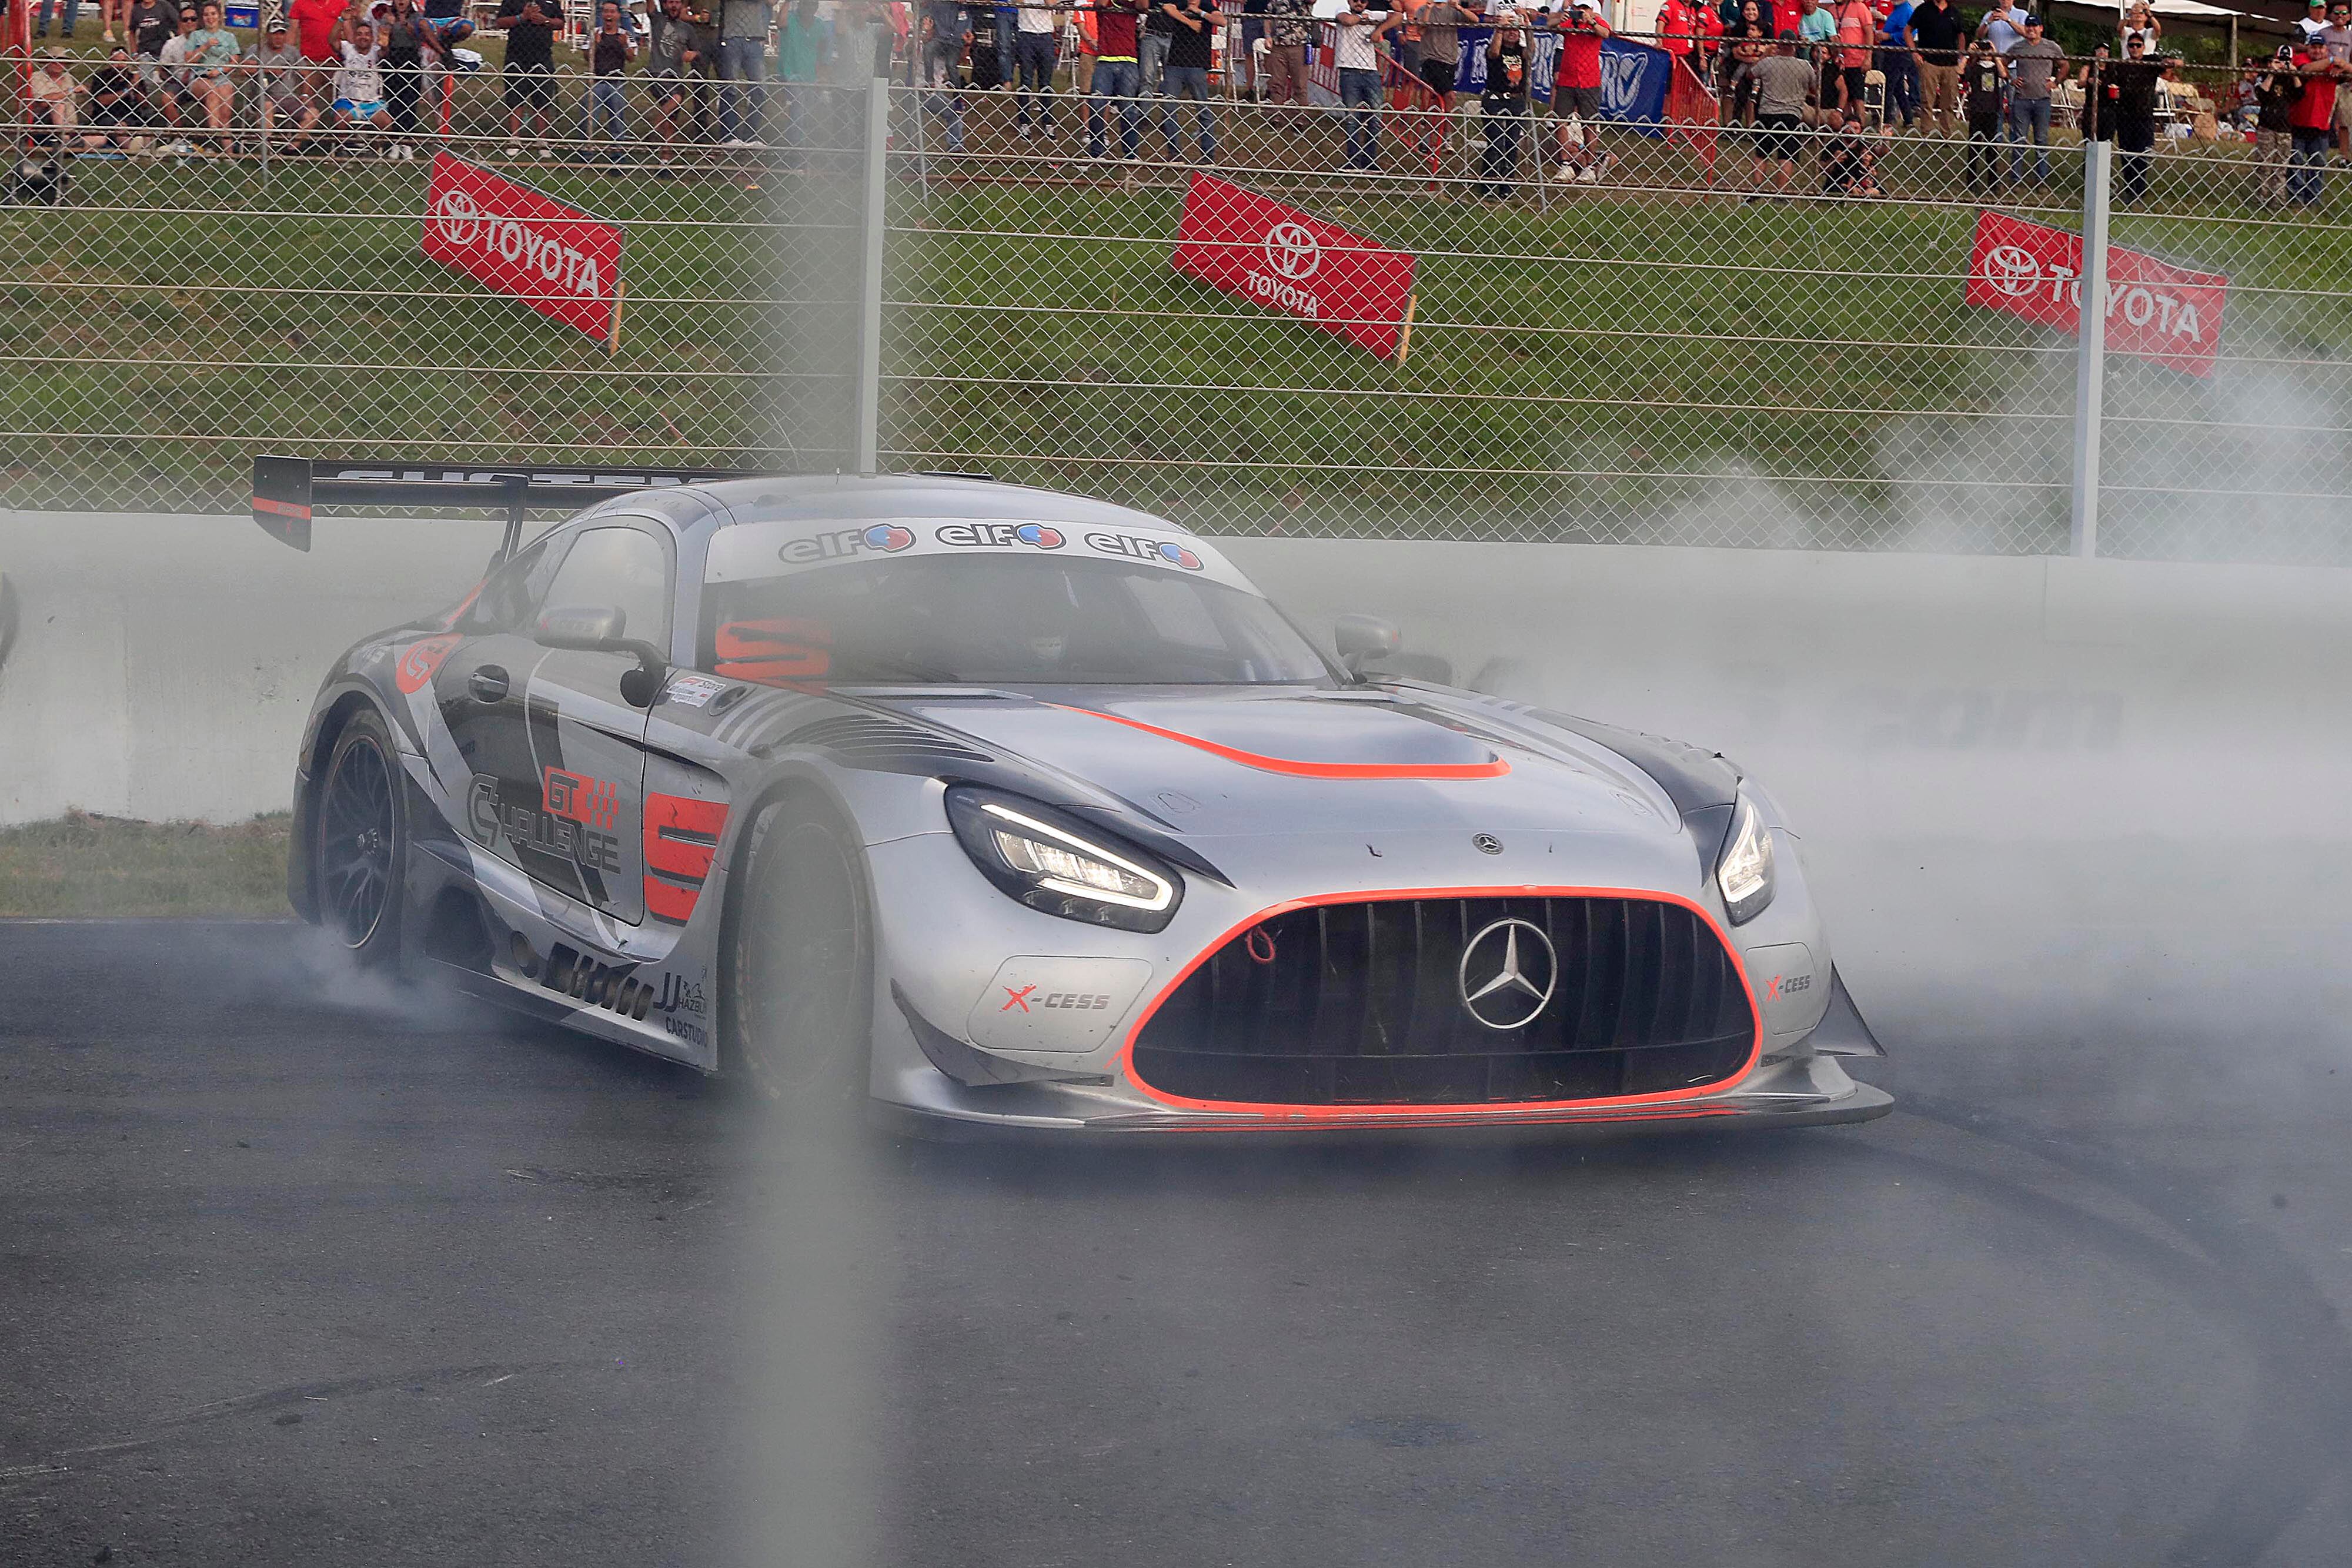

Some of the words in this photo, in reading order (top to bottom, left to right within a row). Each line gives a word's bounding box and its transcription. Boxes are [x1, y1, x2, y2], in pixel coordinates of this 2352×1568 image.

[485, 211, 599, 299] TOYOTA
[1247, 270, 1318, 318] TOYOTA
[778, 529, 860, 564] elf
[935, 524, 1014, 547] elf
[1084, 533, 1157, 561] elf
[548, 772, 579, 816] GT
[467, 773, 622, 875] CHALLENGE
[1000, 984, 1111, 1013] X-CESS
[1765, 974, 1810, 1002] X-CESS
